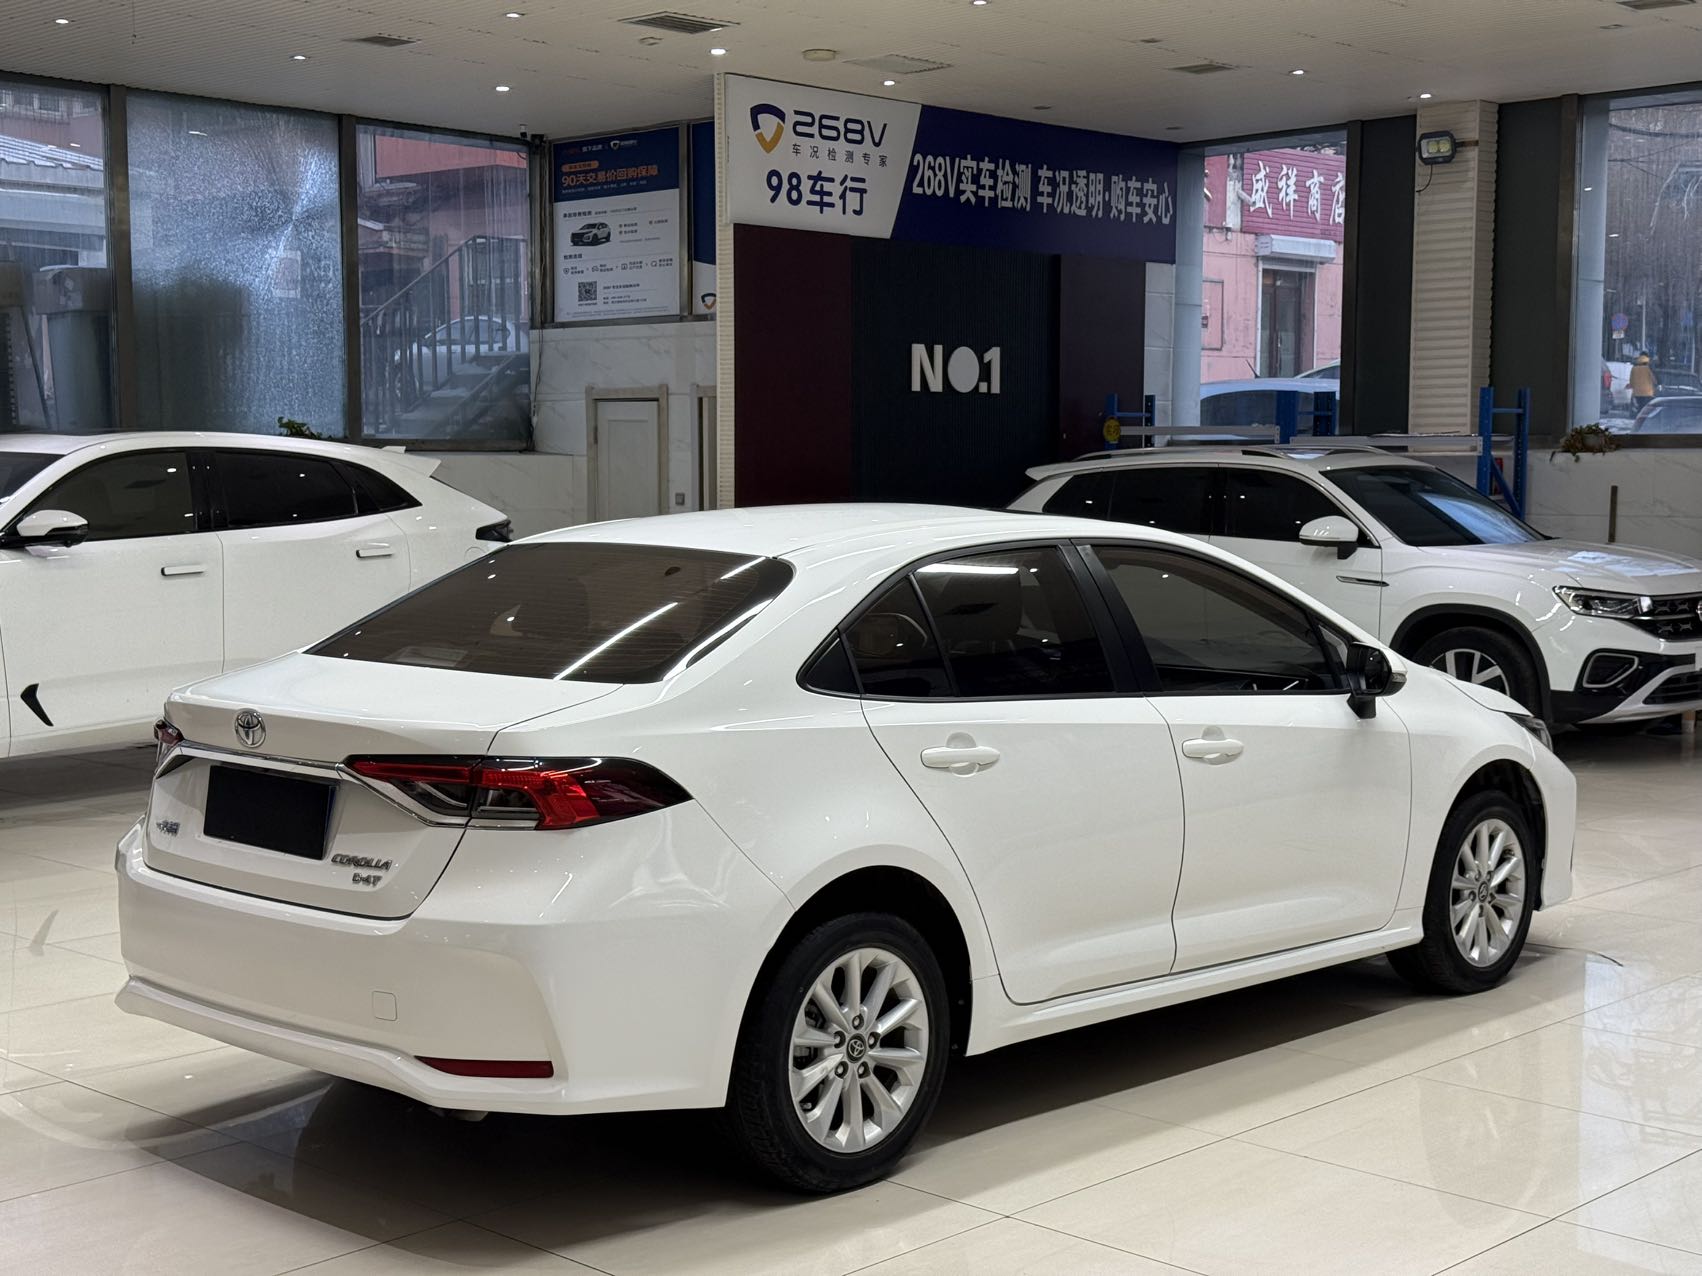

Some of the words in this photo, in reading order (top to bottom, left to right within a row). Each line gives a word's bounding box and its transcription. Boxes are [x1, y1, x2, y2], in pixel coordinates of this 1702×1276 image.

[792, 109, 888, 148] 268V
[791, 142, 889, 168] 车况检测专家
[561, 164, 659, 188] 90天交易价回购保障
[766, 168, 868, 216] 98车行
[912, 153, 1032, 212] 268V实车检测
[1036, 164, 1173, 225] 车况透明·购车安心
[911, 343, 1001, 394] NO.1
[331, 853, 393, 871] COROLLA
